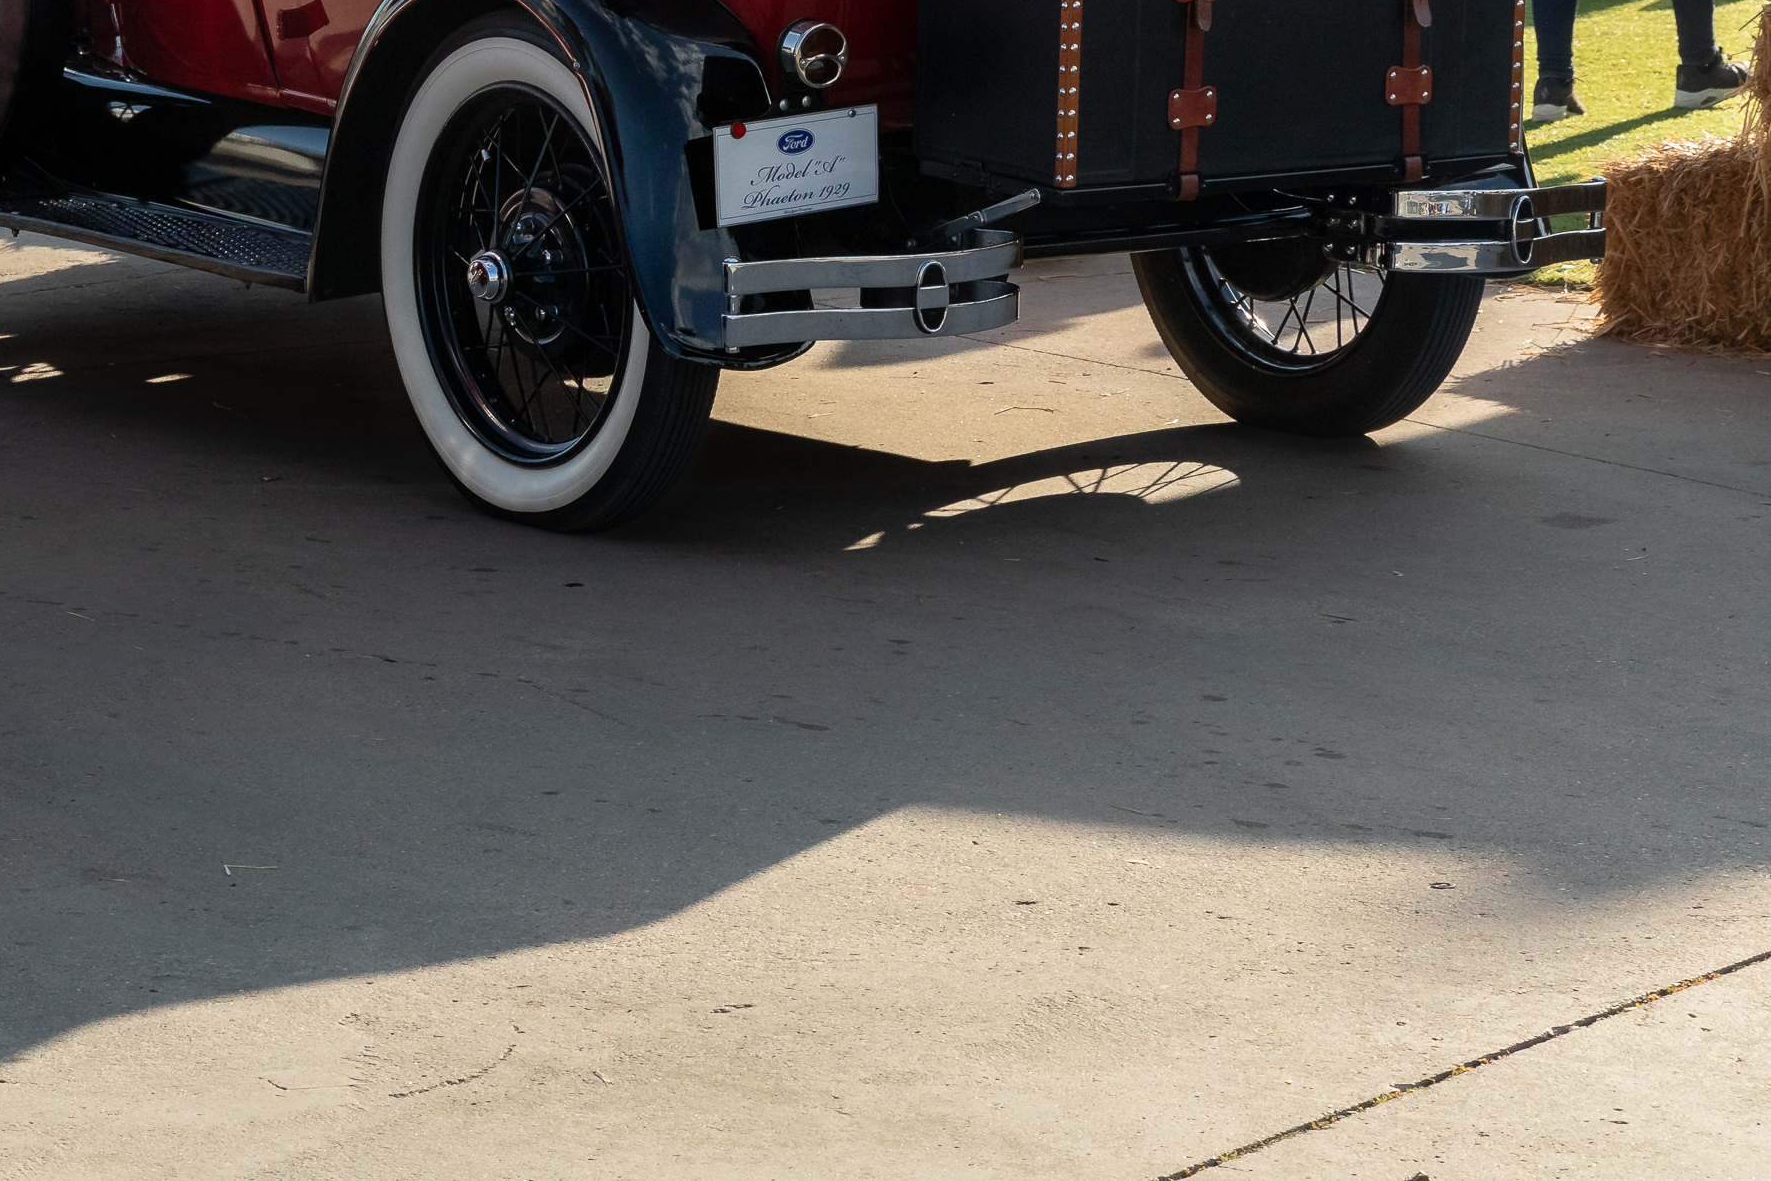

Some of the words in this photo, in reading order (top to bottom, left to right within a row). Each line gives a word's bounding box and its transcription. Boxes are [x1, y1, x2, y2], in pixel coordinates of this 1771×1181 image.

[783, 133, 809, 151] Ford
[750, 159, 813, 186] Model
[741, 184, 815, 210] Phaeton
[818, 182, 850, 200] 1929
